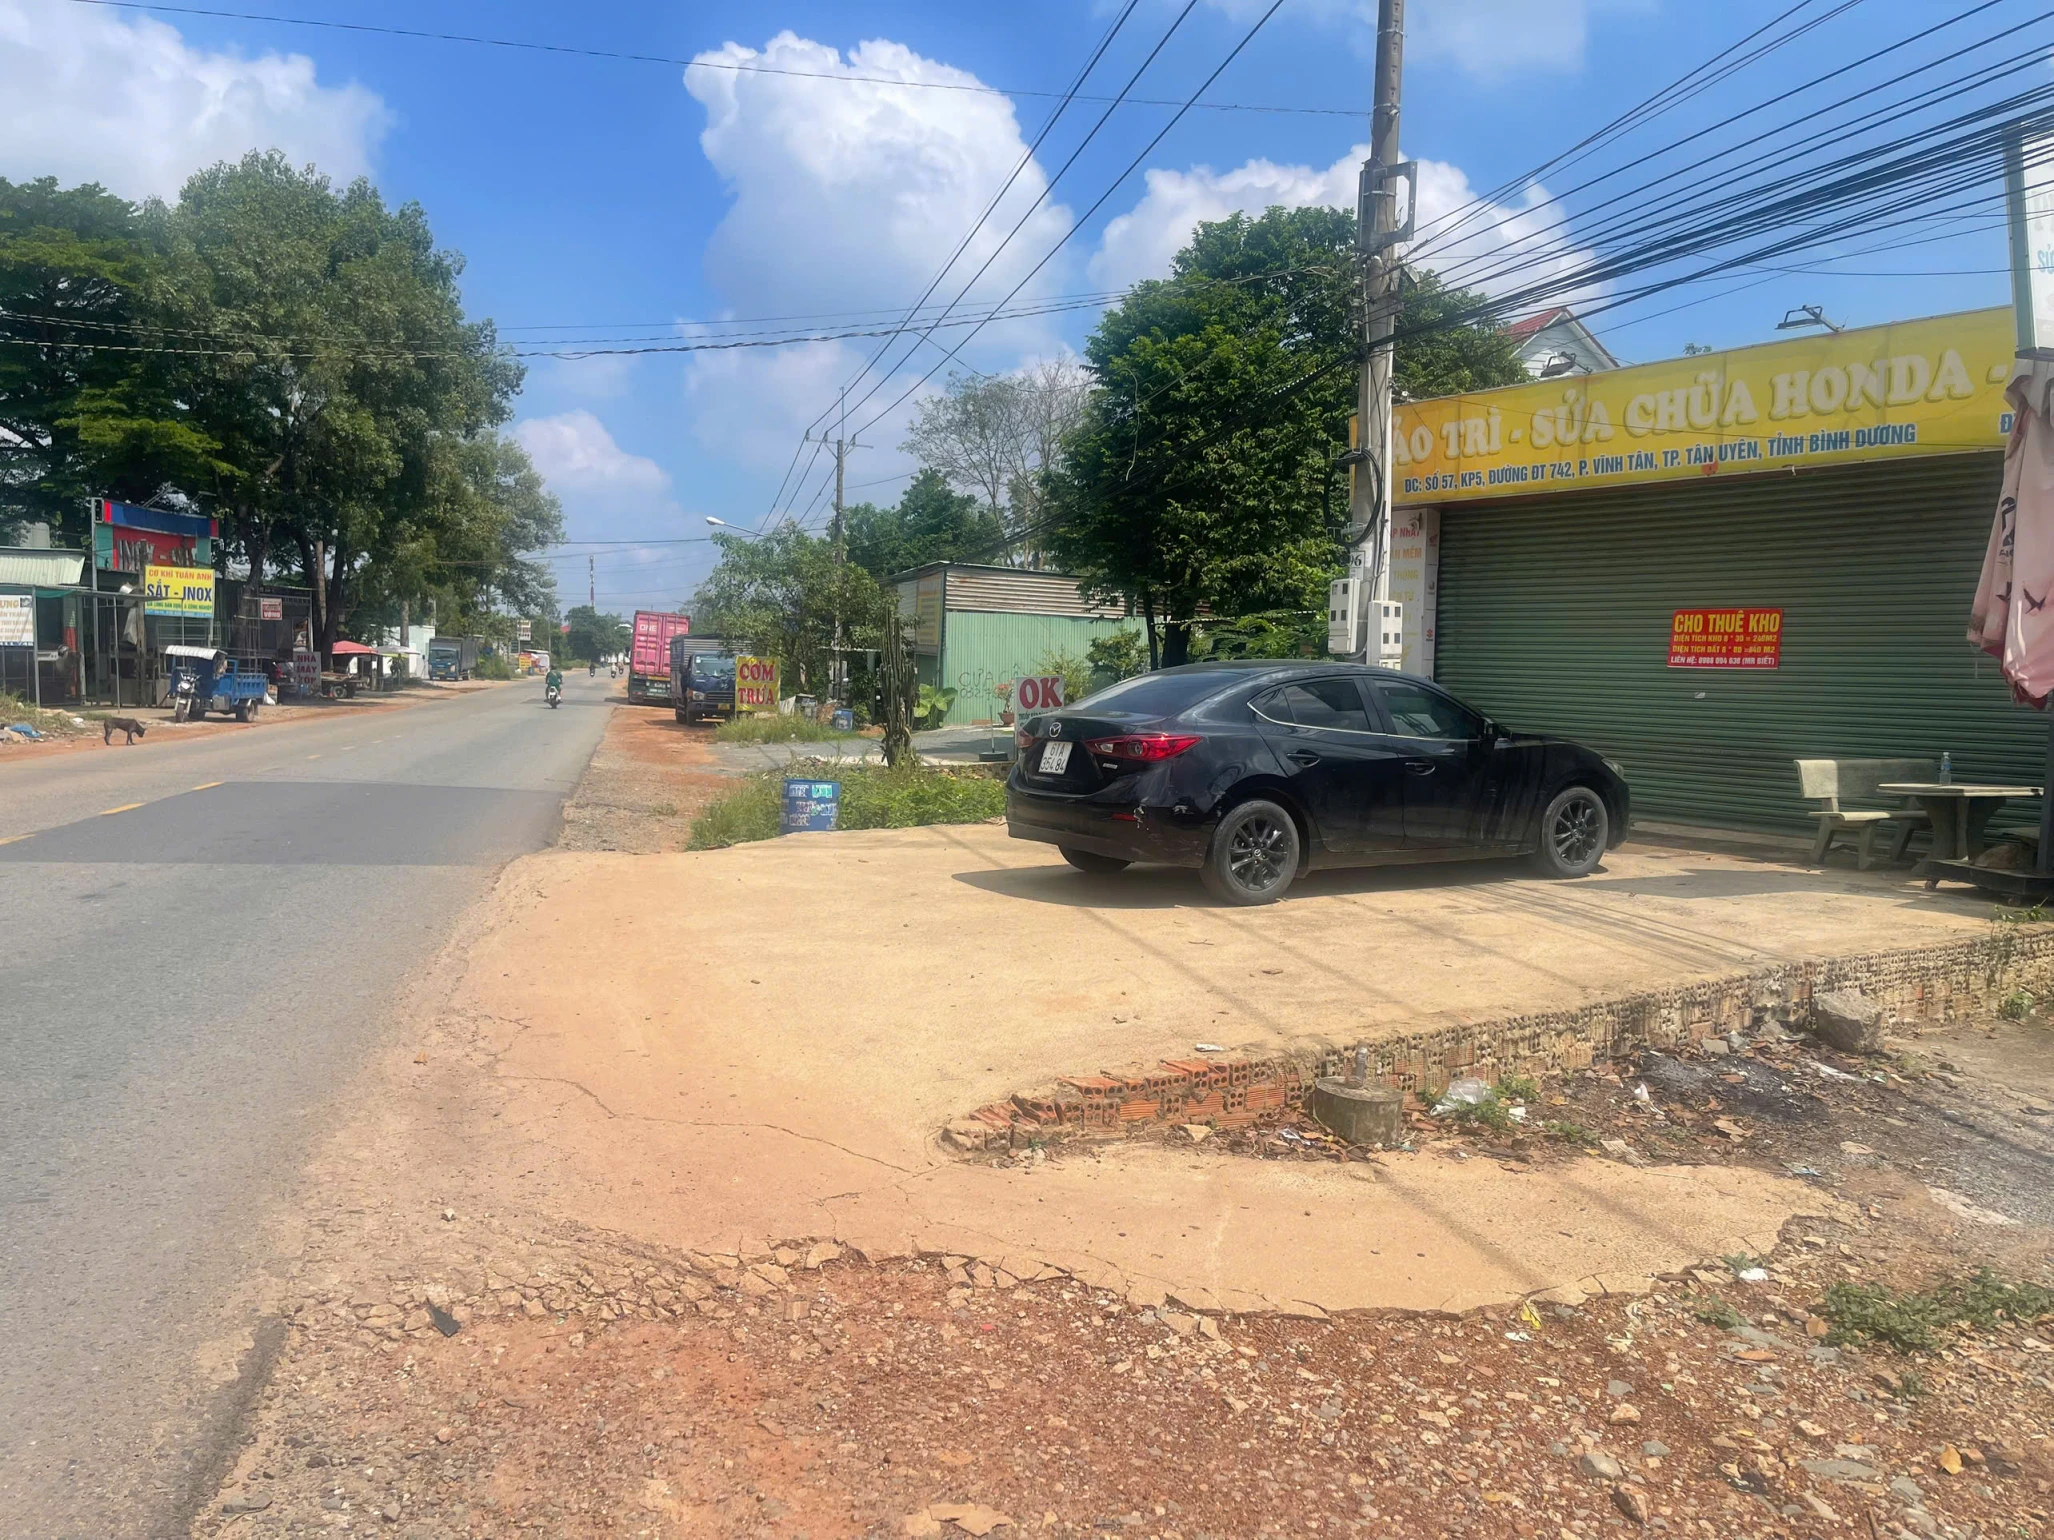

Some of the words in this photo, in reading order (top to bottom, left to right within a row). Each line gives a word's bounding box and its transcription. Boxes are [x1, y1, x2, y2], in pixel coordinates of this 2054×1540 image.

[1391, 415, 1433, 465] ẢO
[1530, 388, 1614, 449] SỬA
[1624, 371, 1758, 438] CHỮA
[1769, 348, 1975, 421] HONDA
[2000, 413, 2016, 434] Đ
[1404, 477, 1422, 493] ĐC:
[1425, 470, 1440, 491] SỐ
[1441, 473, 1458, 490] 57,
[1460, 471, 1485, 488] KP5,
[1488, 464, 1528, 484] ĐƯỜNG
[1531, 464, 1547, 481] ĐT
[1550, 461, 1575, 479] 742,
[1579, 460, 1589, 476] P.
[1593, 454, 1623, 474] VĨNH
[1627, 450, 1658, 471] TÂN,
[1662, 449, 1681, 467] TP.
[1686, 444, 1714, 465] TÂN
[1718, 438, 1763, 461] UYÊN,
[1768, 432, 1804, 456] TỈNH
[1809, 429, 1850, 453] BÌNH
[1855, 422, 1916, 448] DƯƠNG
[197, 573, 212, 581] ANH
[147, 579, 170, 598] SẮT
[183, 586, 212, 602] INOX
[639, 624, 657, 632] ONE
[1674, 614, 1703, 633] CHO
[1708, 610, 1745, 633] THUÊ
[1748, 613, 1780, 633] KHO
[1708, 634, 1722, 642] KHO
[739, 661, 775, 681] CƠM
[738, 684, 775, 705] TRƯA
[1019, 678, 1062, 709] OK
[1050, 743, 1065, 757] 61A
